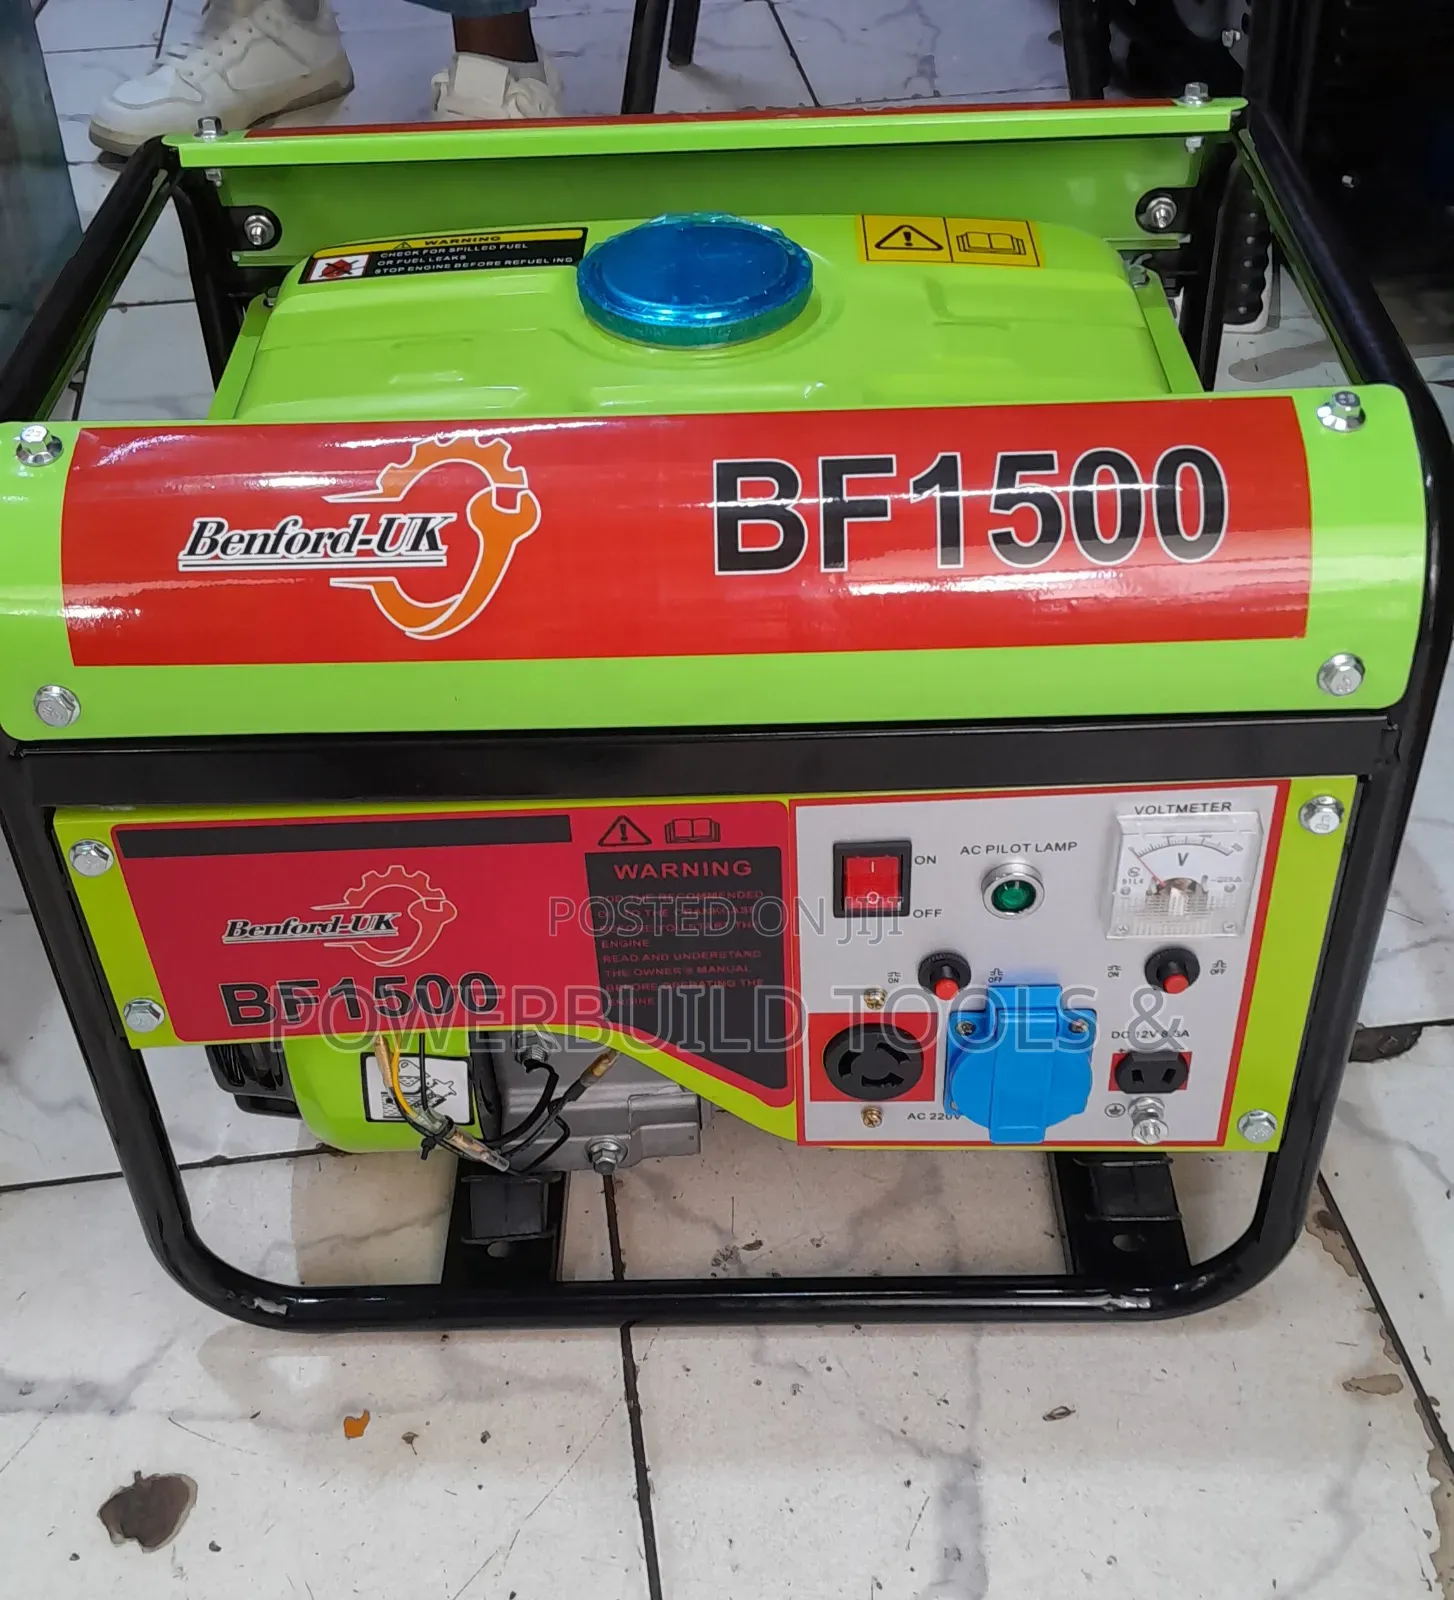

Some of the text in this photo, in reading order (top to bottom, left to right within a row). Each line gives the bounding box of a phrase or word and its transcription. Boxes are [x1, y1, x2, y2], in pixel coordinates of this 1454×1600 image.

[424, 235, 501, 246] WARNING
[380, 249, 420, 258] CHECK
[422, 247, 446, 255] FOR
[448, 244, 497, 253] SPILLED
[396, 257, 426, 265] FUEL
[428, 254, 467, 263] LEAKS
[374, 266, 405, 275] STOP
[407, 263, 451, 272] ENGINE
[454, 260, 501, 269] BEFORE
[179, 445, 1230, 576] Benford-UK BF1500
[1134, 801, 1232, 815] VOLTMETER
[960, 841, 1078, 855] AC PILOT LAMP
[914, 855, 937, 866] ON
[1177, 852, 1190, 867] V
[613, 860, 752, 880] WARNING
[913, 908, 943, 919] OFF
[223, 912, 402, 940] Benford-UK
[601, 938, 650, 949] ENGINE
[602, 949, 762, 964] READ AND UNDERSTAND
[604, 969, 631, 978] THE
[696, 965, 751, 975] MANUAL
[219, 971, 499, 1027] BF1500
[907, 1112, 926, 1121] AC
